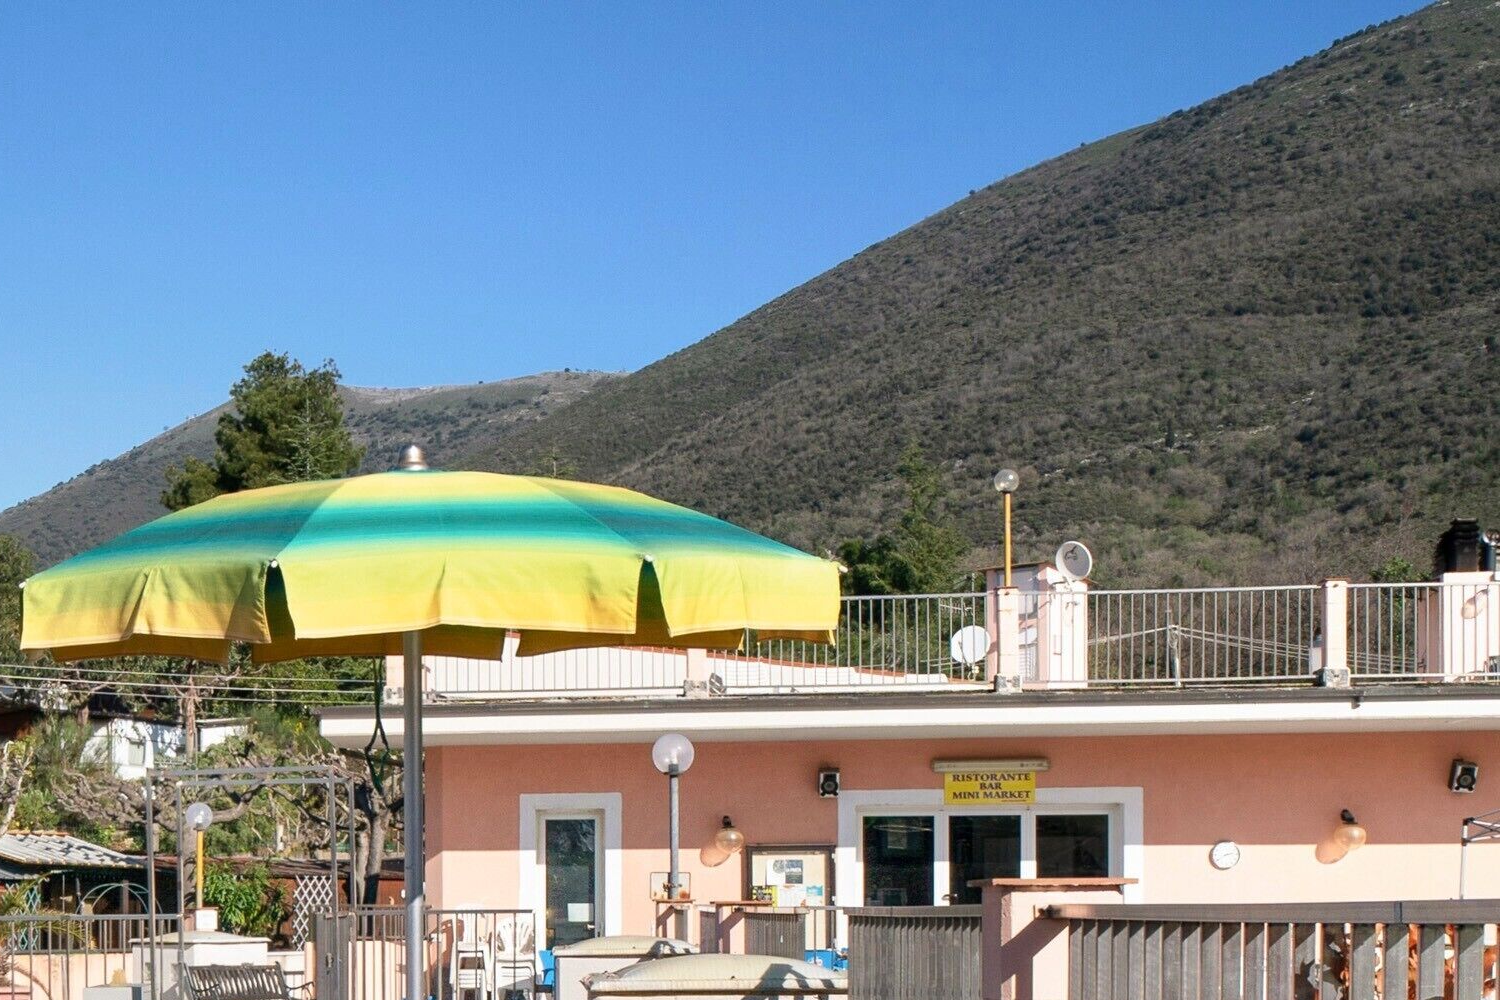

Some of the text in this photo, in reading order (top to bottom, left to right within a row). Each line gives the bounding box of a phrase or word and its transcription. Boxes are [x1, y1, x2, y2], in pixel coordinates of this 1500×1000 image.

[952, 773, 1031, 782] RISTORANTE
[979, 782, 1002, 790] BAR
[952, 790, 1031, 799] MINI MARKET
